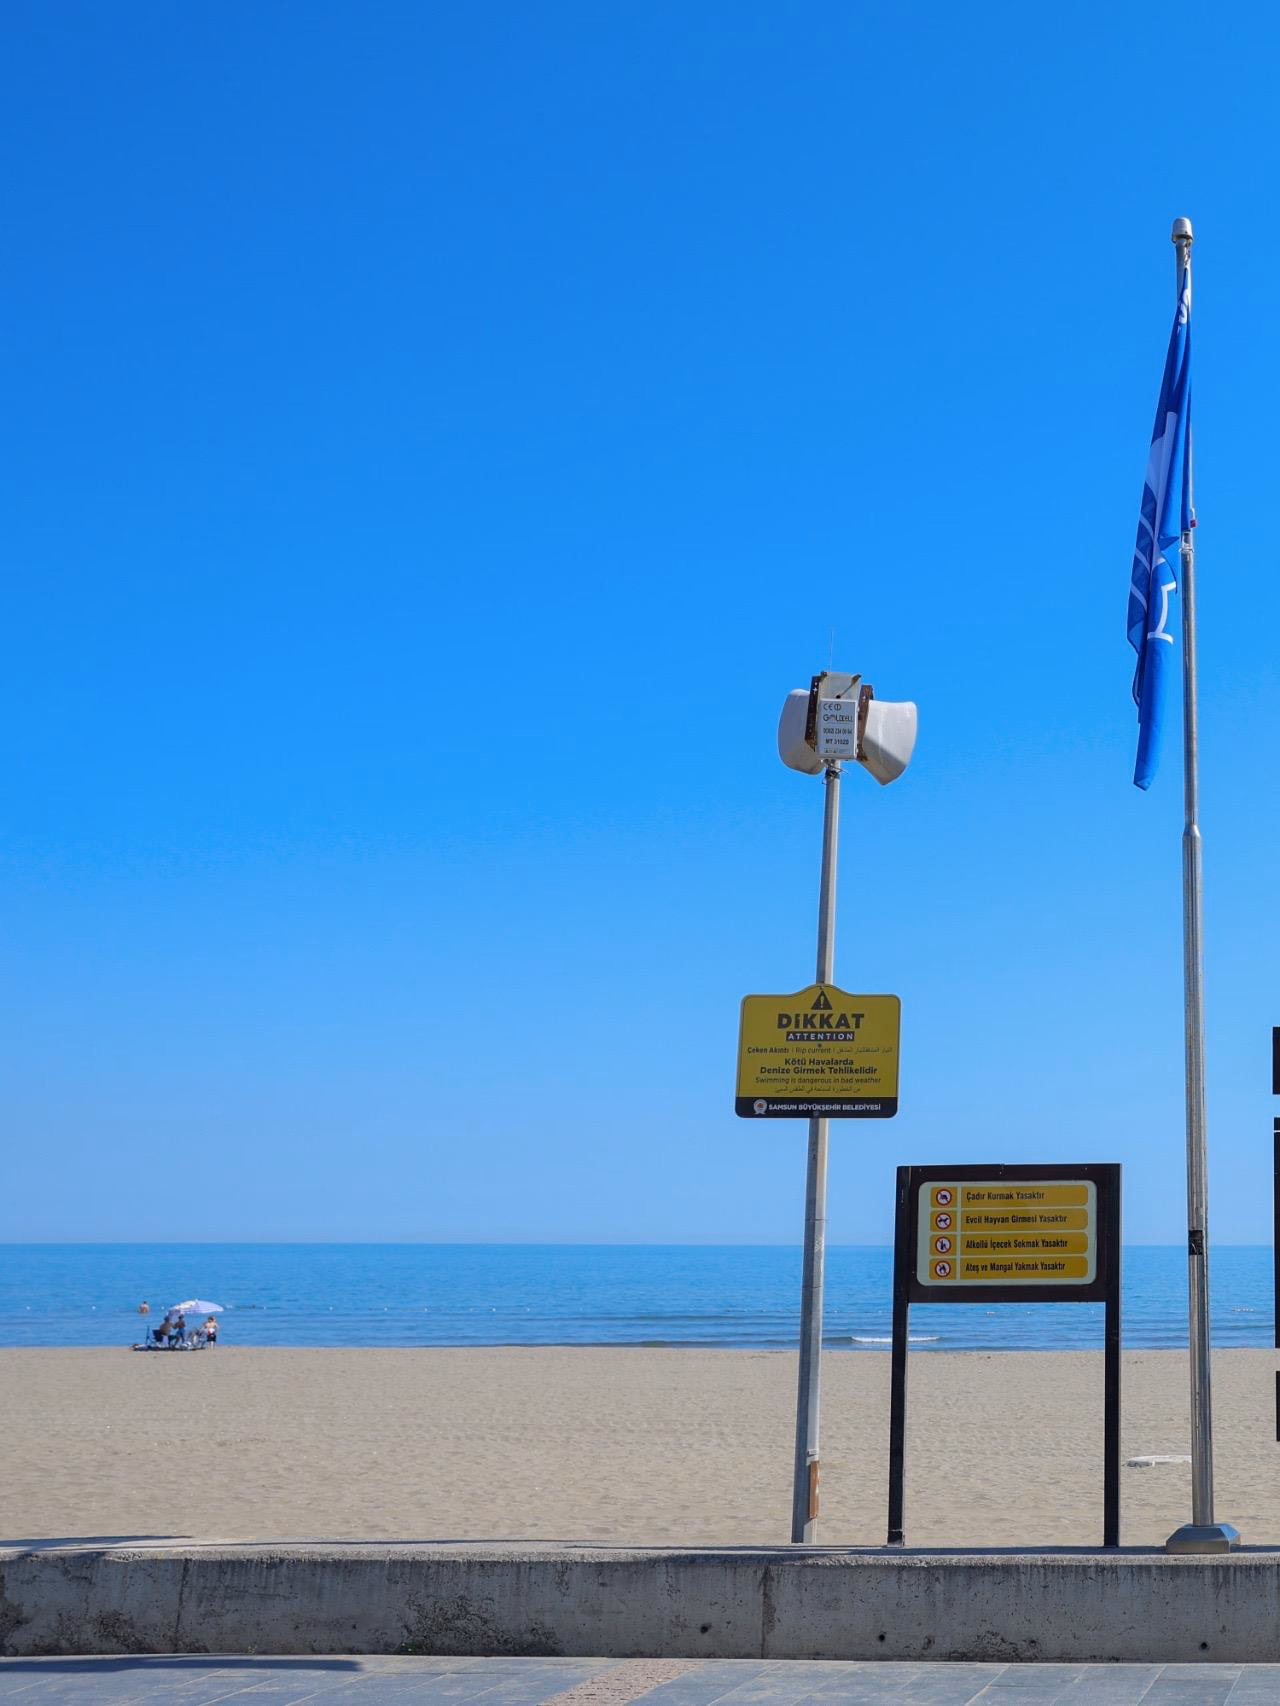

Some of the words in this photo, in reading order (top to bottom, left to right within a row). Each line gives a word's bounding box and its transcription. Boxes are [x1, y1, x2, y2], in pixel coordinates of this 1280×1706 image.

[785, 1058, 807, 1066] Kötü
[809, 1058, 854, 1066] Havalarda
[798, 1077, 832, 1085] dangerous
[798, 1103, 841, 1112] BÜYÜKŞEHİR
[842, 1103, 881, 1111] BELEDİYESİ
[967, 1192, 985, 1202] Çadır
[988, 1192, 1014, 1200] Kurmak
[1016, 1192, 1045, 1200] Yasaktır
[966, 1216, 982, 1224] Evcil
[984, 1215, 1009, 1224] Hayvan
[1011, 1214, 1037, 1223] Girmesi
[1039, 1214, 1067, 1223] Yasaktır
[966, 1240, 988, 1248] Alkollü
[990, 1237, 1012, 1250] İçecek
[1013, 1239, 1040, 1248] Sokmak
[1041, 1239, 1068, 1248] Yasaktır
[966, 1263, 979, 1273] Ateş
[990, 1263, 1013, 1272] Mangal
[1015, 1262, 1039, 1271] Yakmak
[1041, 1262, 1065, 1270] Yasaktır
